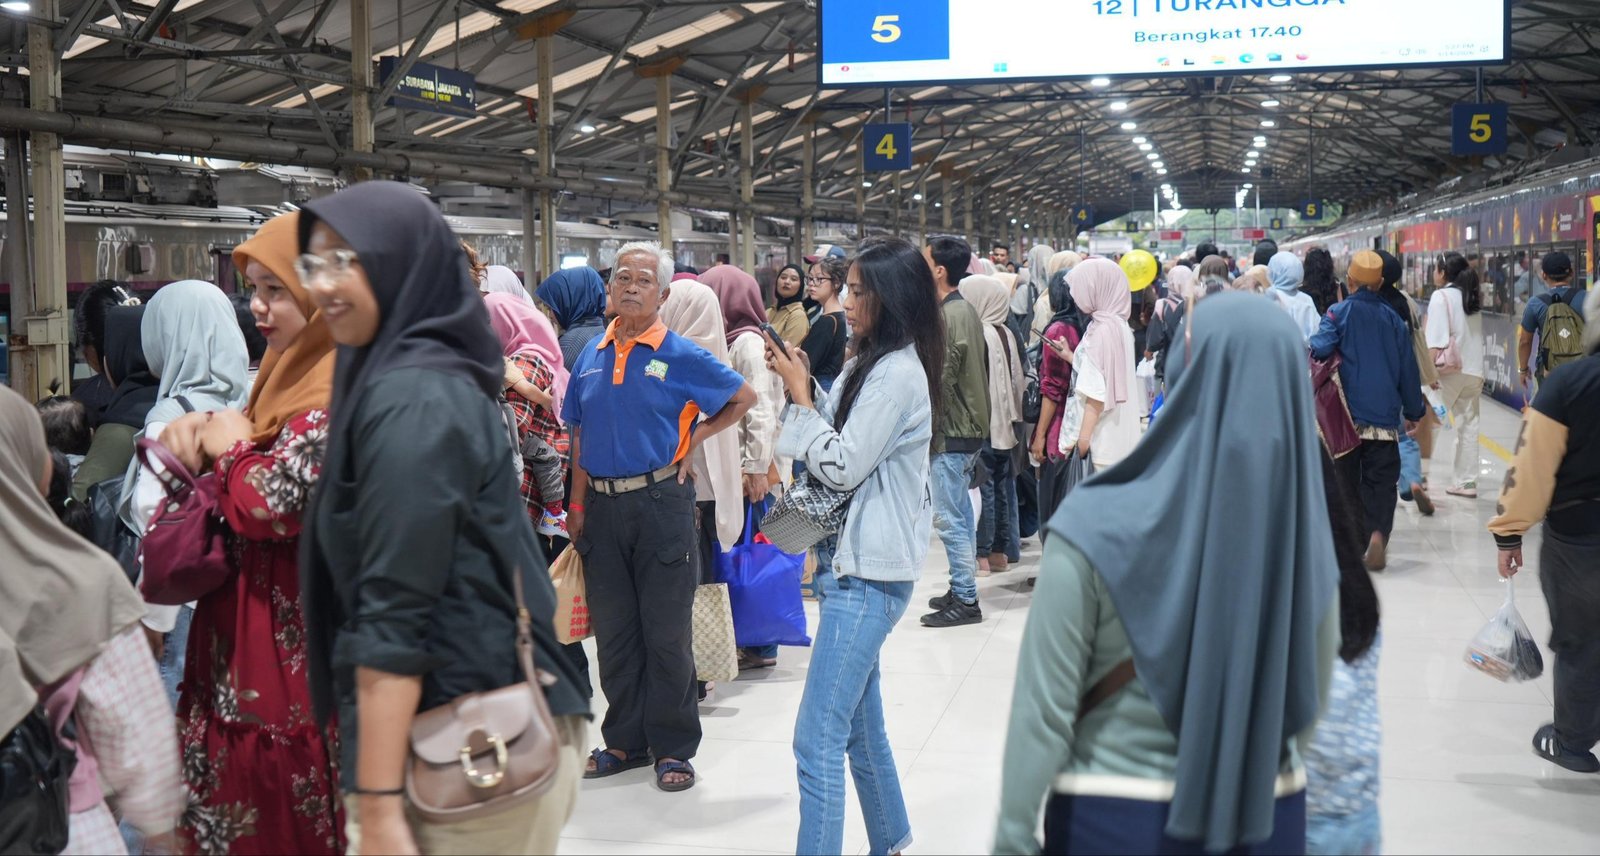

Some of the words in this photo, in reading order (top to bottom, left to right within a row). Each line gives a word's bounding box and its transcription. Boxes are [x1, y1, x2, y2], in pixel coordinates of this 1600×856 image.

[1092, 0, 1122, 15] 12
[1155, 0, 1346, 12] TURAN
[870, 15, 902, 44] 5
[1134, 28, 1242, 43] Berangkat
[1250, 26, 1302, 37] 17.40
[438, 82, 461, 96] JAKARTA
[1469, 114, 1492, 143] 5
[875, 133, 898, 160] 4
[1077, 209, 1087, 221] 4
[1306, 203, 1317, 217] 5
